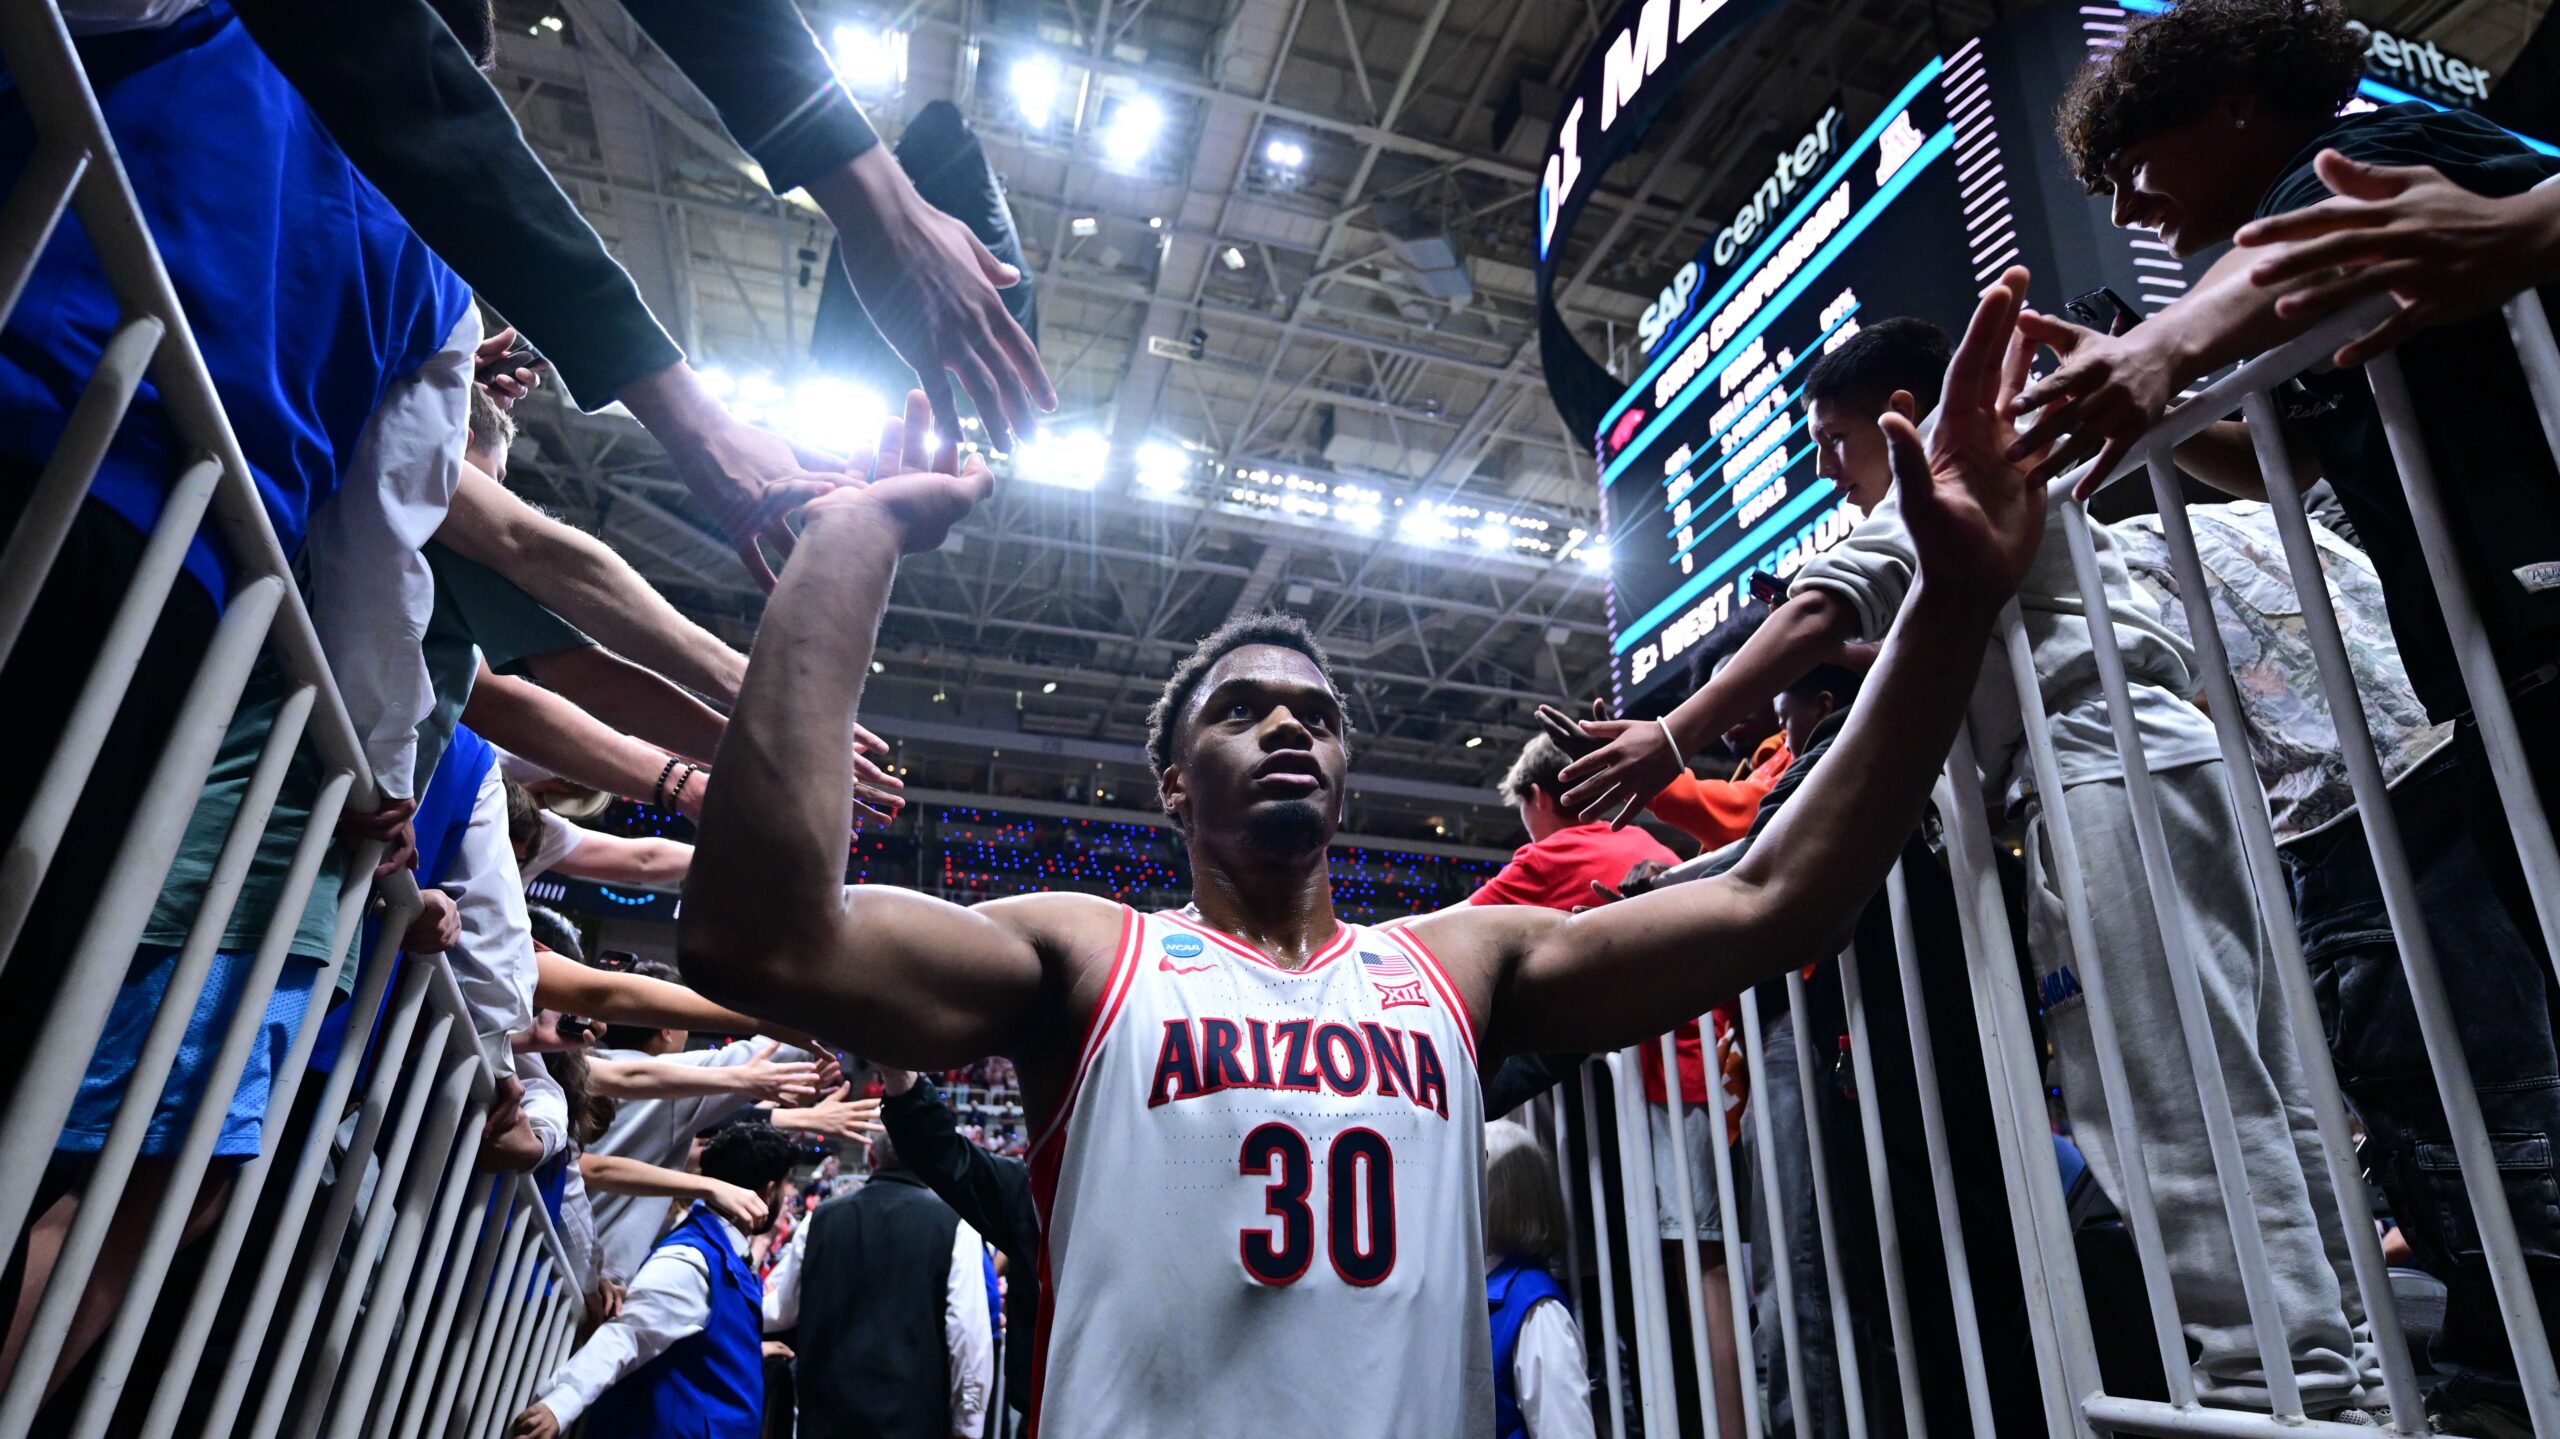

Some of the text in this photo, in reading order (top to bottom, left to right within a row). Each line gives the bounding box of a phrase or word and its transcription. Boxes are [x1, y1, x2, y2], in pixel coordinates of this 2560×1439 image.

[1639, 105, 1837, 354] SAP center
[1655, 332, 1709, 408] STATS
[1710, 181, 1850, 352] COMPARISON
[1732, 445, 1788, 507] ASSISTS
[1738, 476, 1787, 529] STEALS
[1661, 582, 1734, 662] WEST
[1375, 981, 1428, 1008] XII
[1148, 1018, 1449, 1121] ARIZONA
[1240, 1122, 1397, 1287] 30
